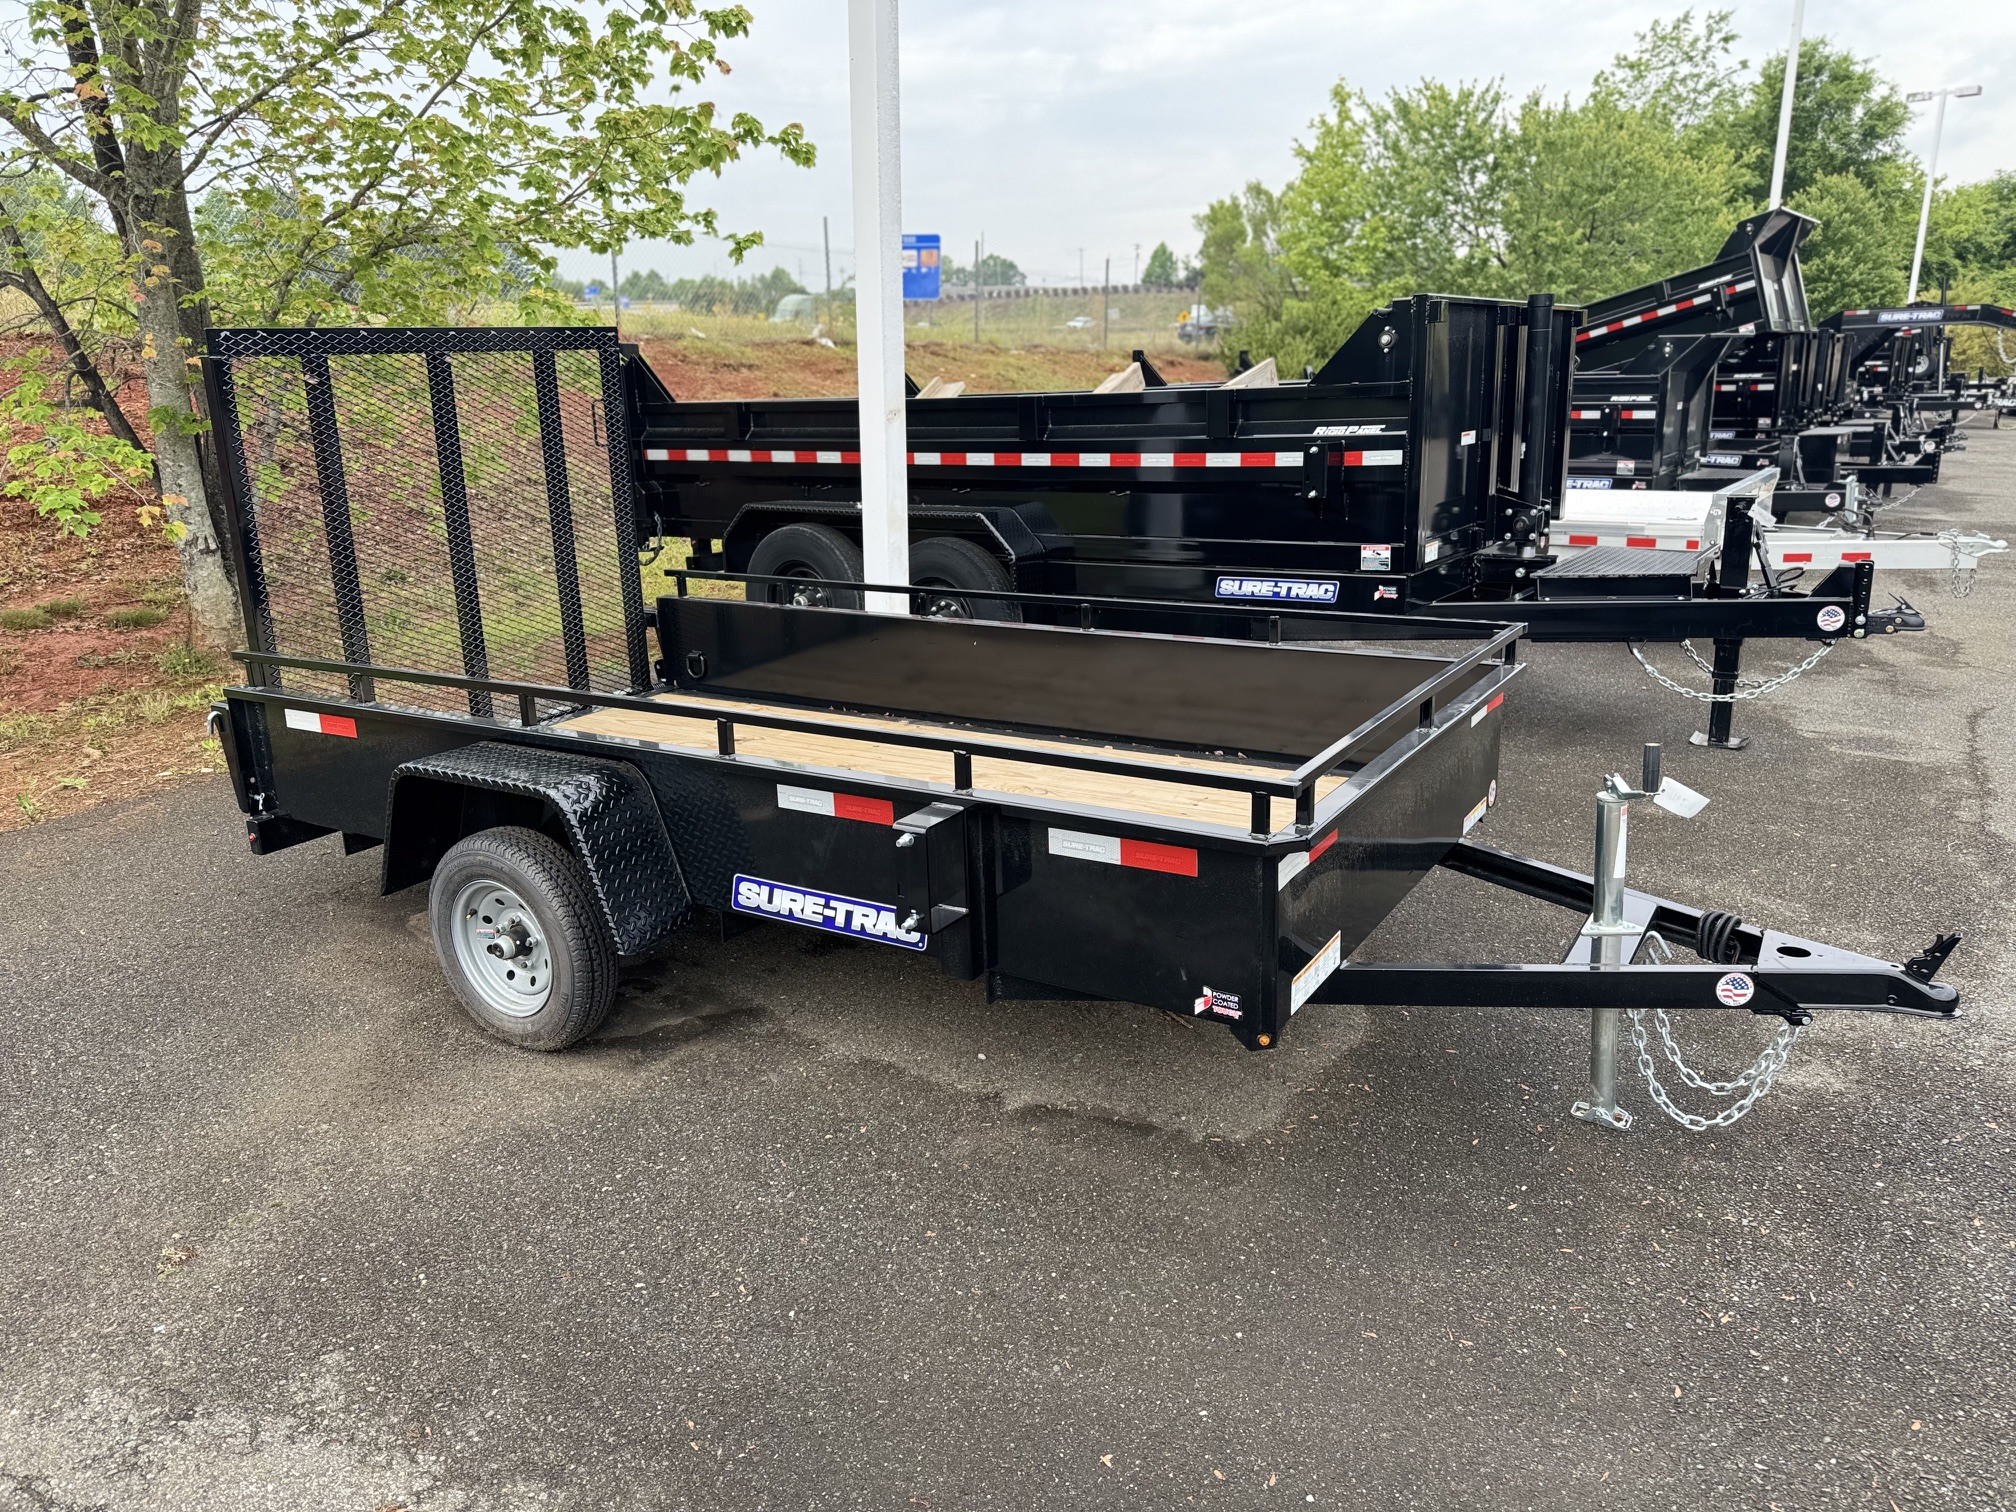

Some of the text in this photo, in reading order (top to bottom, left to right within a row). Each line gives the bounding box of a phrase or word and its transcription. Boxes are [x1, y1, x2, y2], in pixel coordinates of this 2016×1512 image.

[1880, 310, 1942, 321] SURE-TRAC
[1700, 455, 1739, 464] E-TRAC
[1567, 480, 1609, 489] E-TRAC
[1219, 580, 1334, 599] SURE-TRAC
[1063, 841, 1106, 853] SURE-TRAC
[1135, 852, 1182, 865] SURE-TRAC
[1212, 991, 1239, 1003] POWDER
[1212, 998, 1239, 1009] COATED
